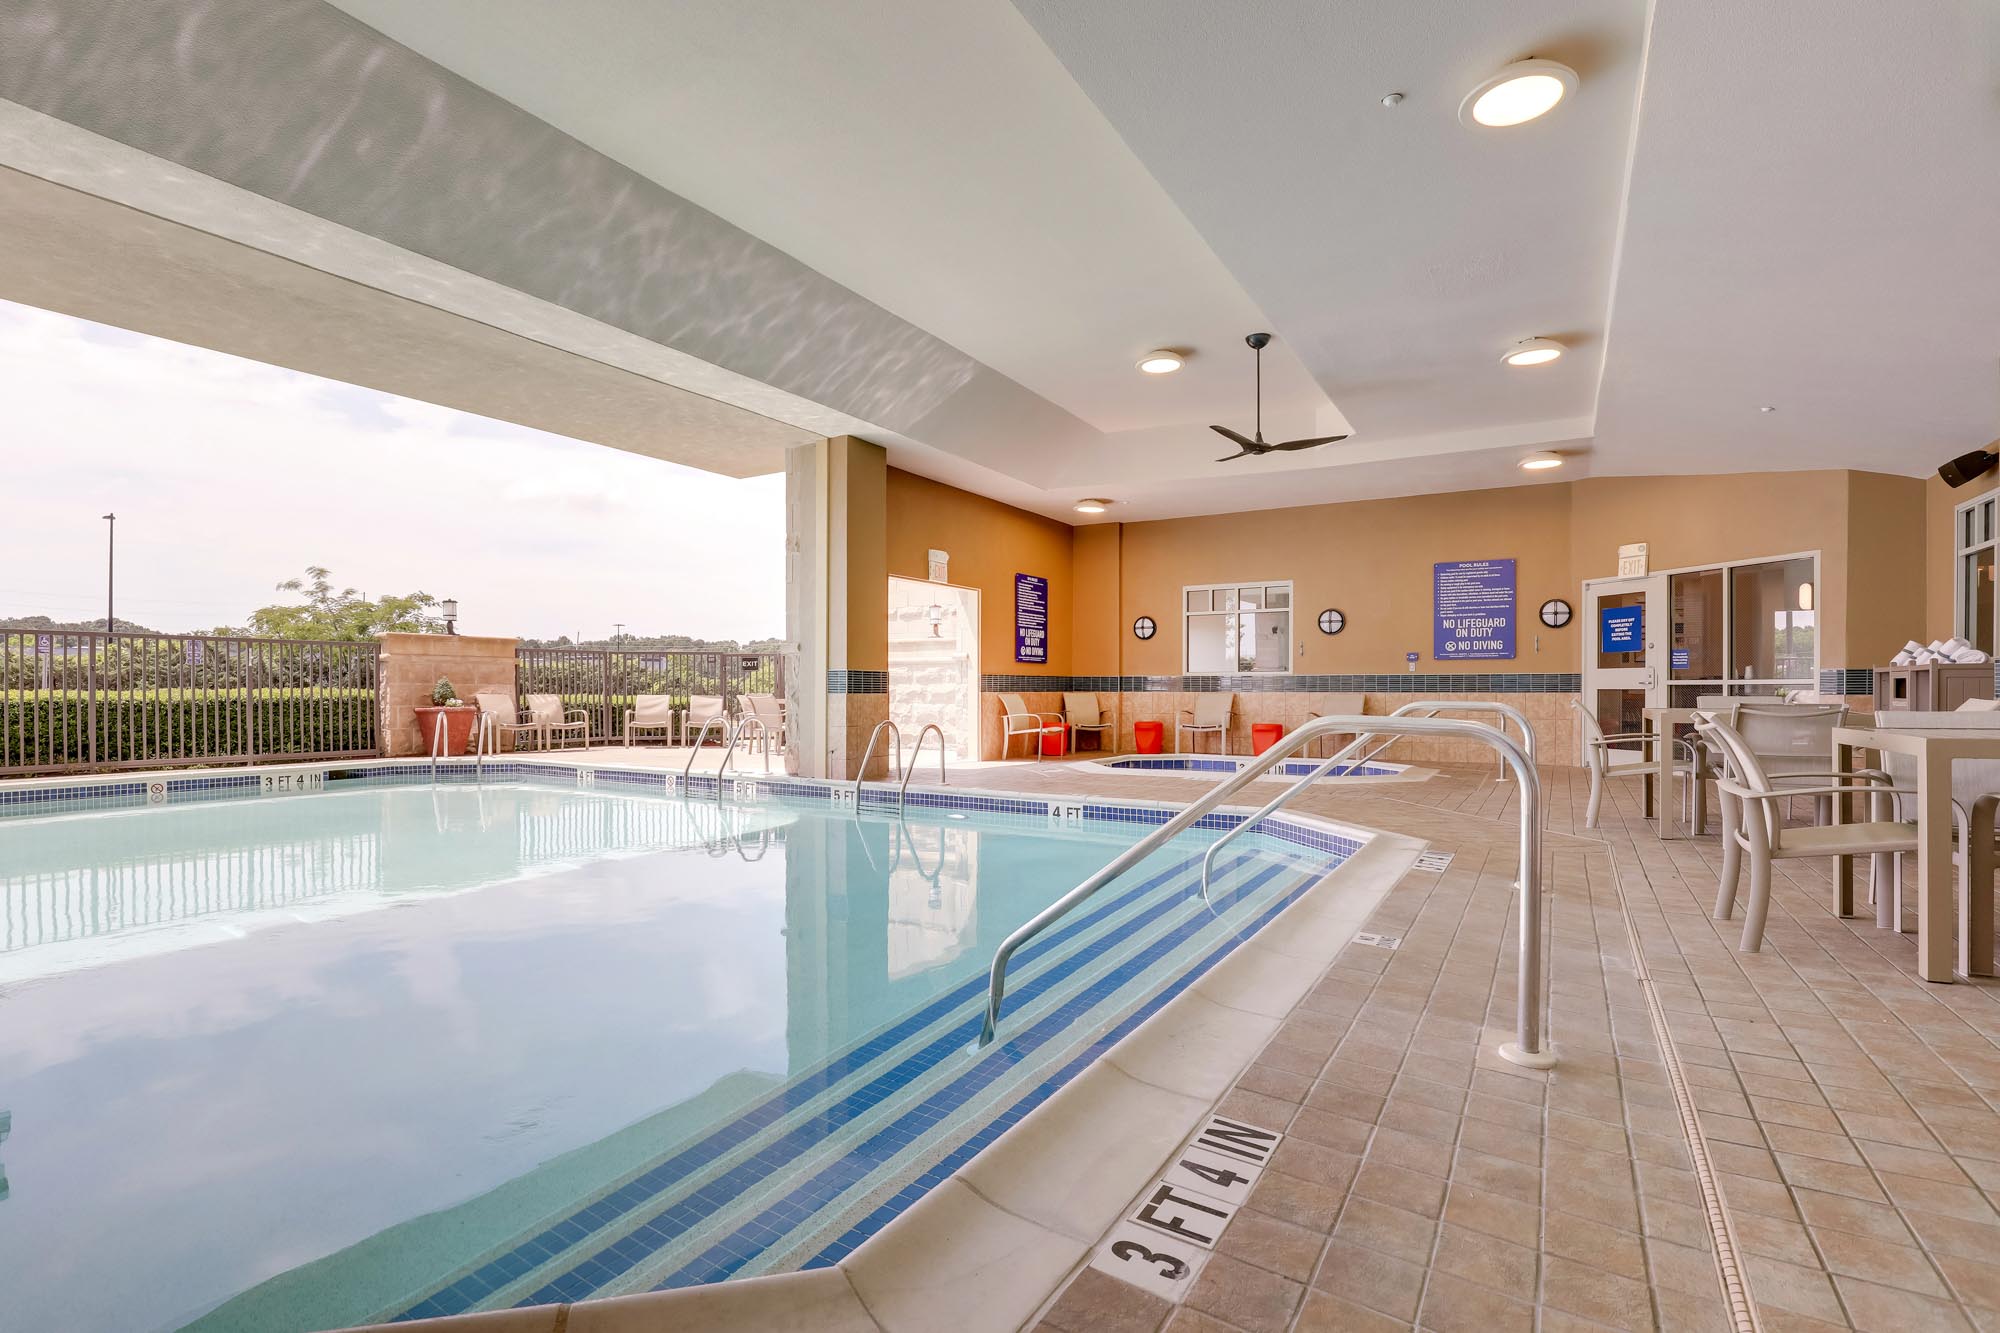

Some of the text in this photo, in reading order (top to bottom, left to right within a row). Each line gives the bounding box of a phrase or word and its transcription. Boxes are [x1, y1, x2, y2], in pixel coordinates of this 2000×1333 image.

[1623, 559, 1641, 576] EXIT
[1443, 618, 1506, 628] NO LIFEGUARD
[1026, 628, 1044, 638] LIFEGUARD
[1456, 628, 1492, 638] ON DUTY
[1458, 640, 1503, 650] NO DIVING
[1274, 765, 1284, 775] IN
[265, 774, 321, 786] 3 FT 4 IN
[737, 782, 755, 794] 5 FT
[834, 790, 855, 800] 5 FT
[1053, 806, 1081, 819] 4 FT
[1112, 1118, 1277, 1281] 3 FT 4 IN
